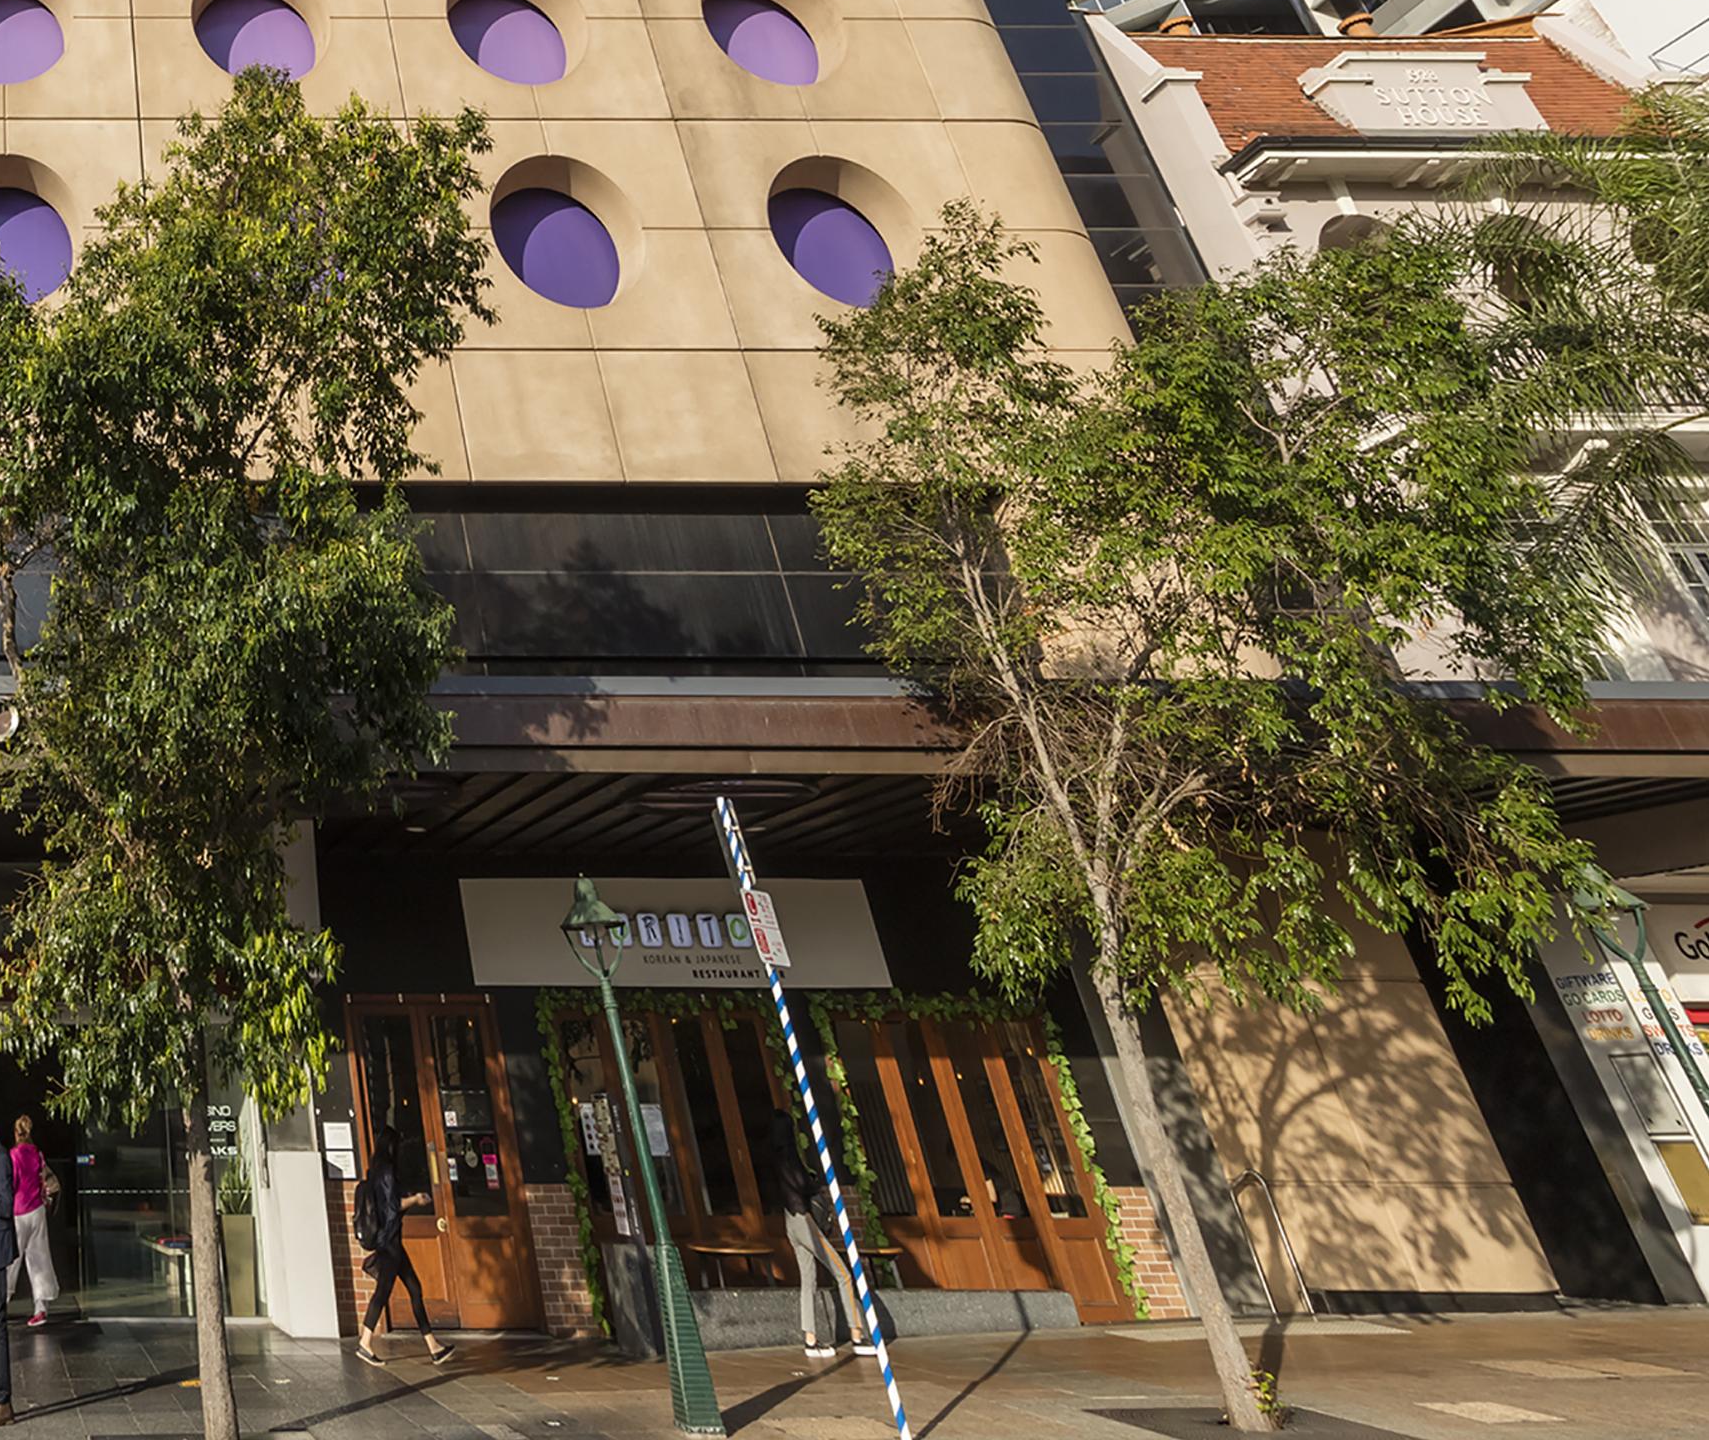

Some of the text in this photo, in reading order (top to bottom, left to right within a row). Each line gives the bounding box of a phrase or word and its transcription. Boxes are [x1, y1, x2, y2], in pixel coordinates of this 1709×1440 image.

[1374, 87, 1493, 106] SUTTON
[1394, 107, 1489, 126] HOUSE
[1674, 931, 1709, 960] Go
[643, 955, 742, 965] KOREAN & JAPANESE
[692, 969, 761, 979] RESTAURANT
[1555, 972, 1617, 990] GIFTWARE
[1562, 989, 1626, 1007] GO CARDS
[1582, 1008, 1624, 1024] LOTTO
[1586, 1026, 1635, 1041] DRINKS
[1641, 1024, 1698, 1038] SWTS
